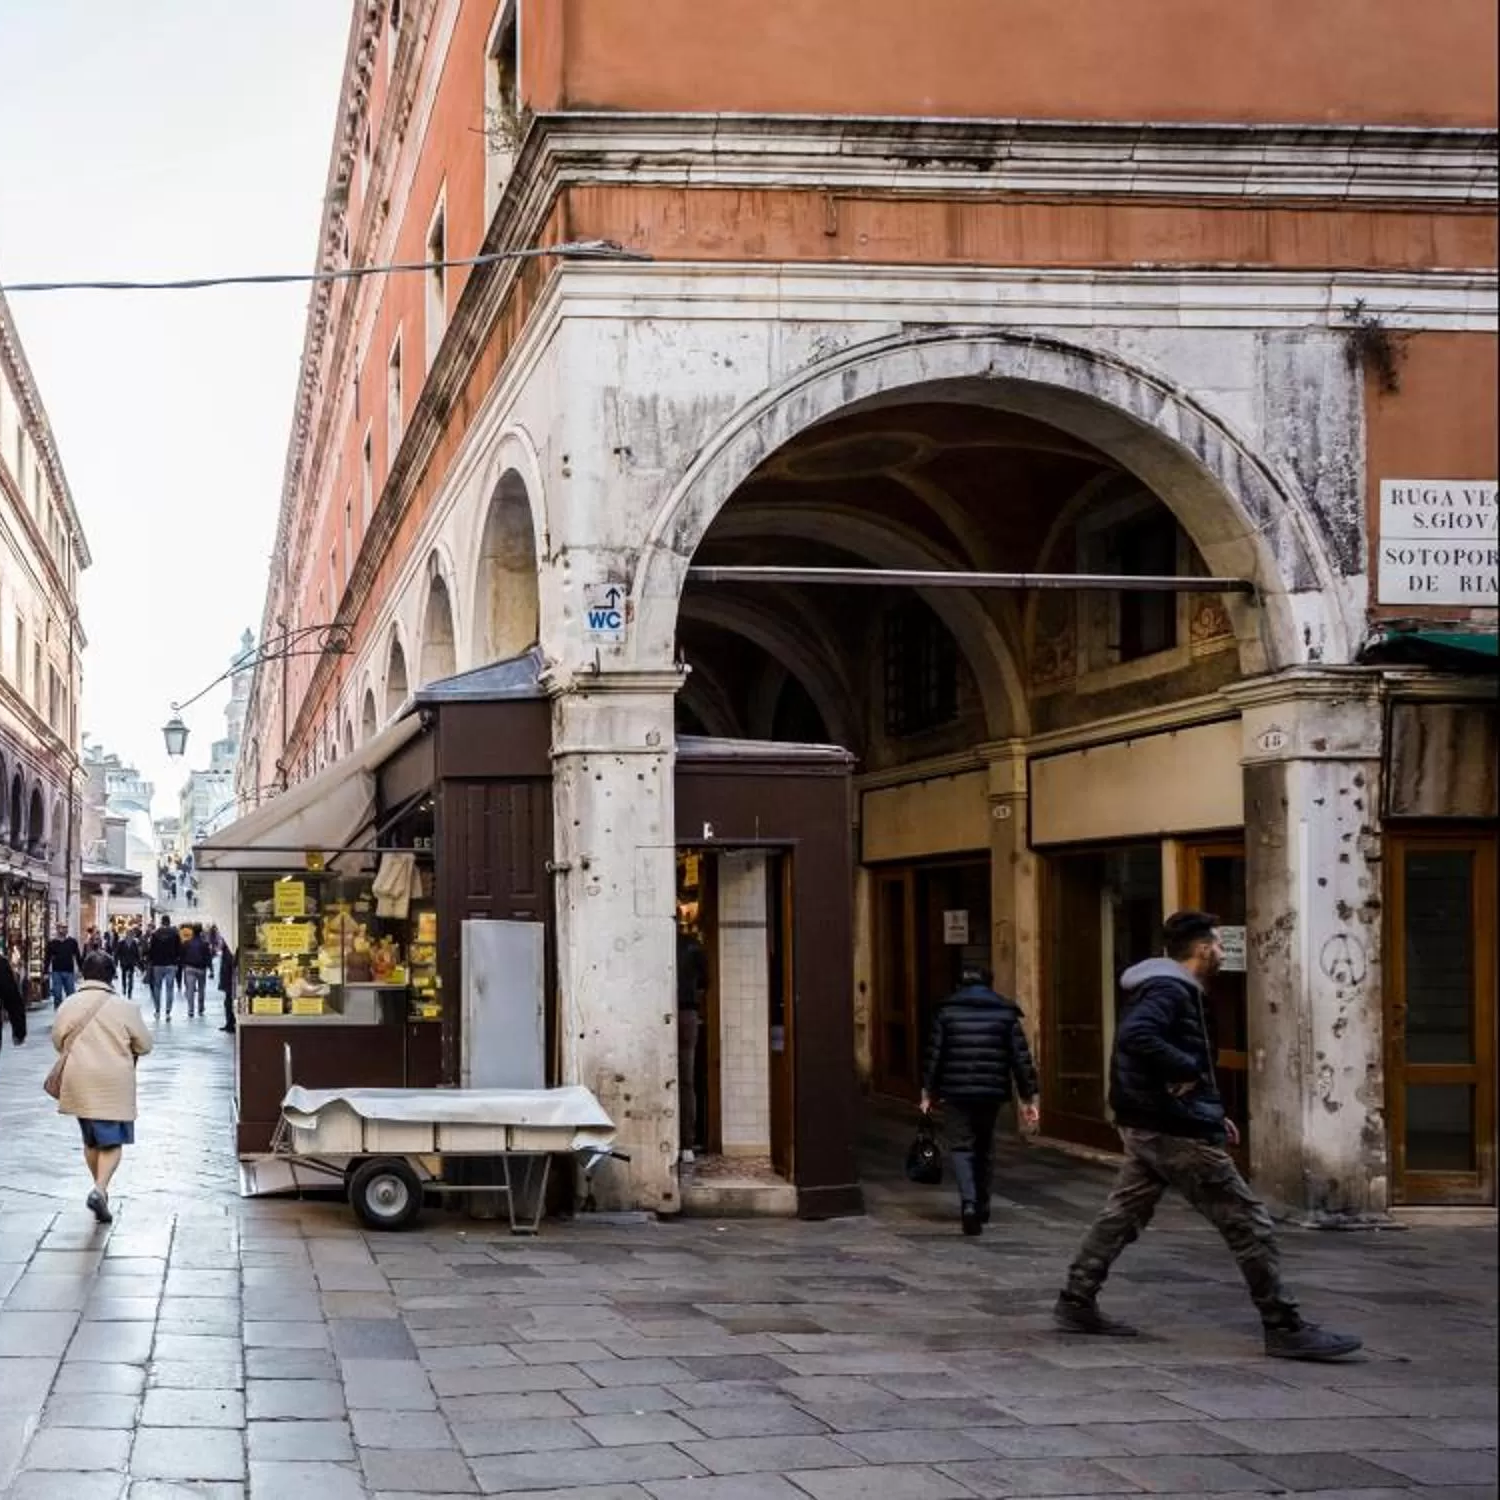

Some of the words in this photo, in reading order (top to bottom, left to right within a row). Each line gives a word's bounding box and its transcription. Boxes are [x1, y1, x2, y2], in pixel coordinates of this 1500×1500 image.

[1391, 488, 1454, 506] RUGA
[1412, 511, 1498, 531] S.GIOV
[1409, 575, 1439, 592] DE
[588, 611, 622, 629] WC
